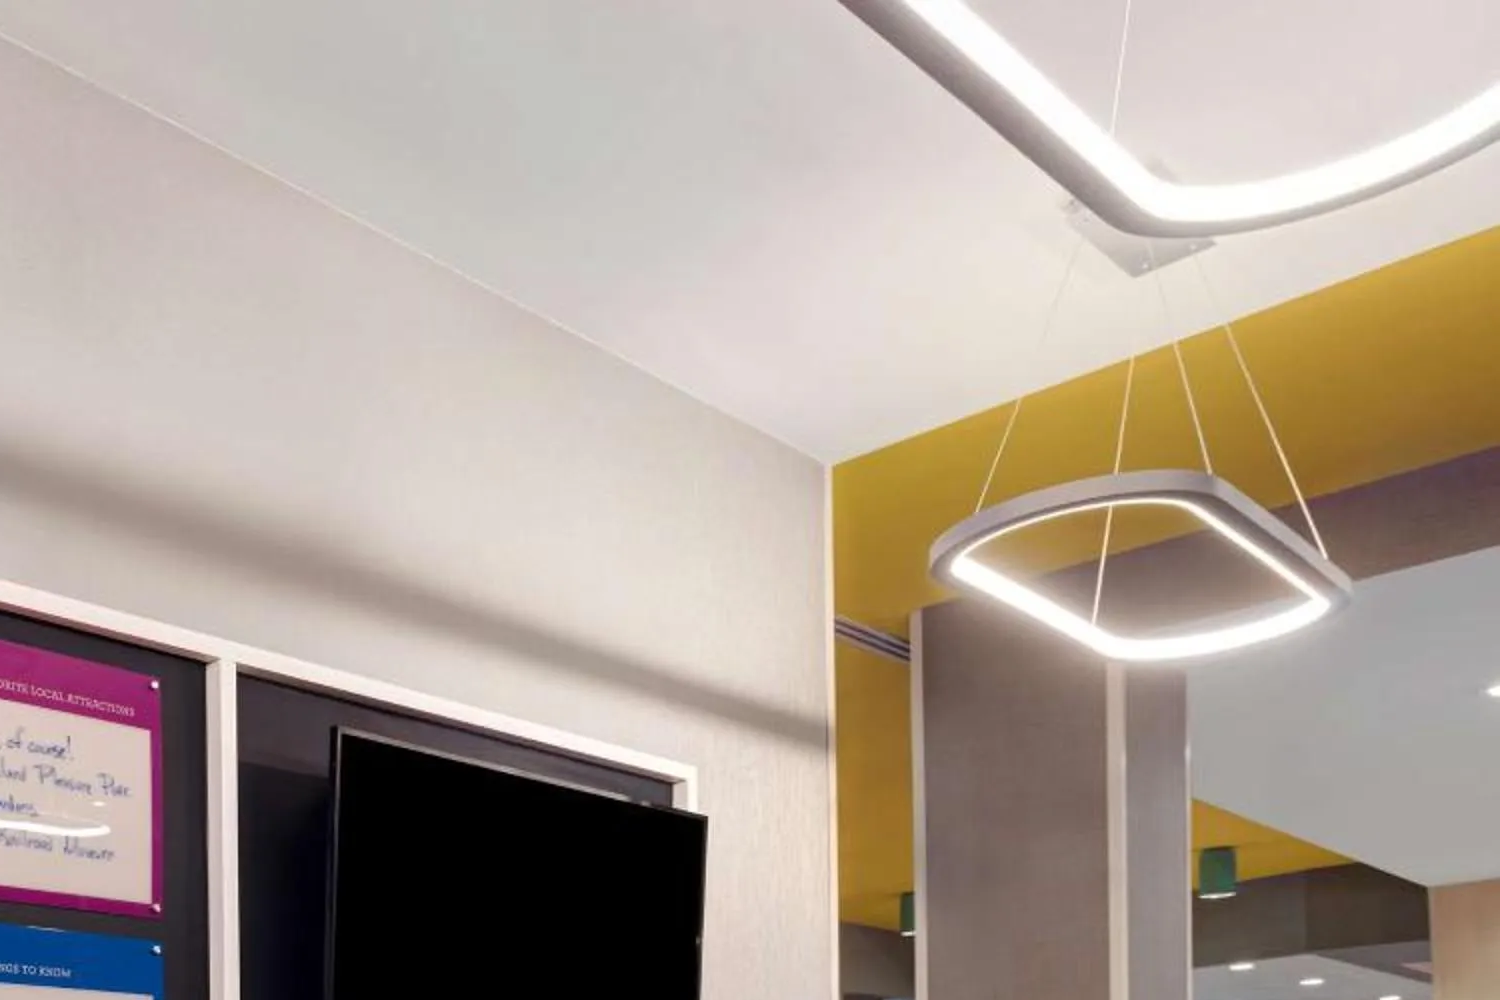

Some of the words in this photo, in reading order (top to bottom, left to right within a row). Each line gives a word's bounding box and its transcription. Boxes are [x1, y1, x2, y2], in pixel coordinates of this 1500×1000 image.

[31, 685, 65, 702] LOCAL
[67, 692, 136, 717] ATTRACTIONS
[22, 964, 37, 975] TO
[39, 965, 72, 978] KNOW
